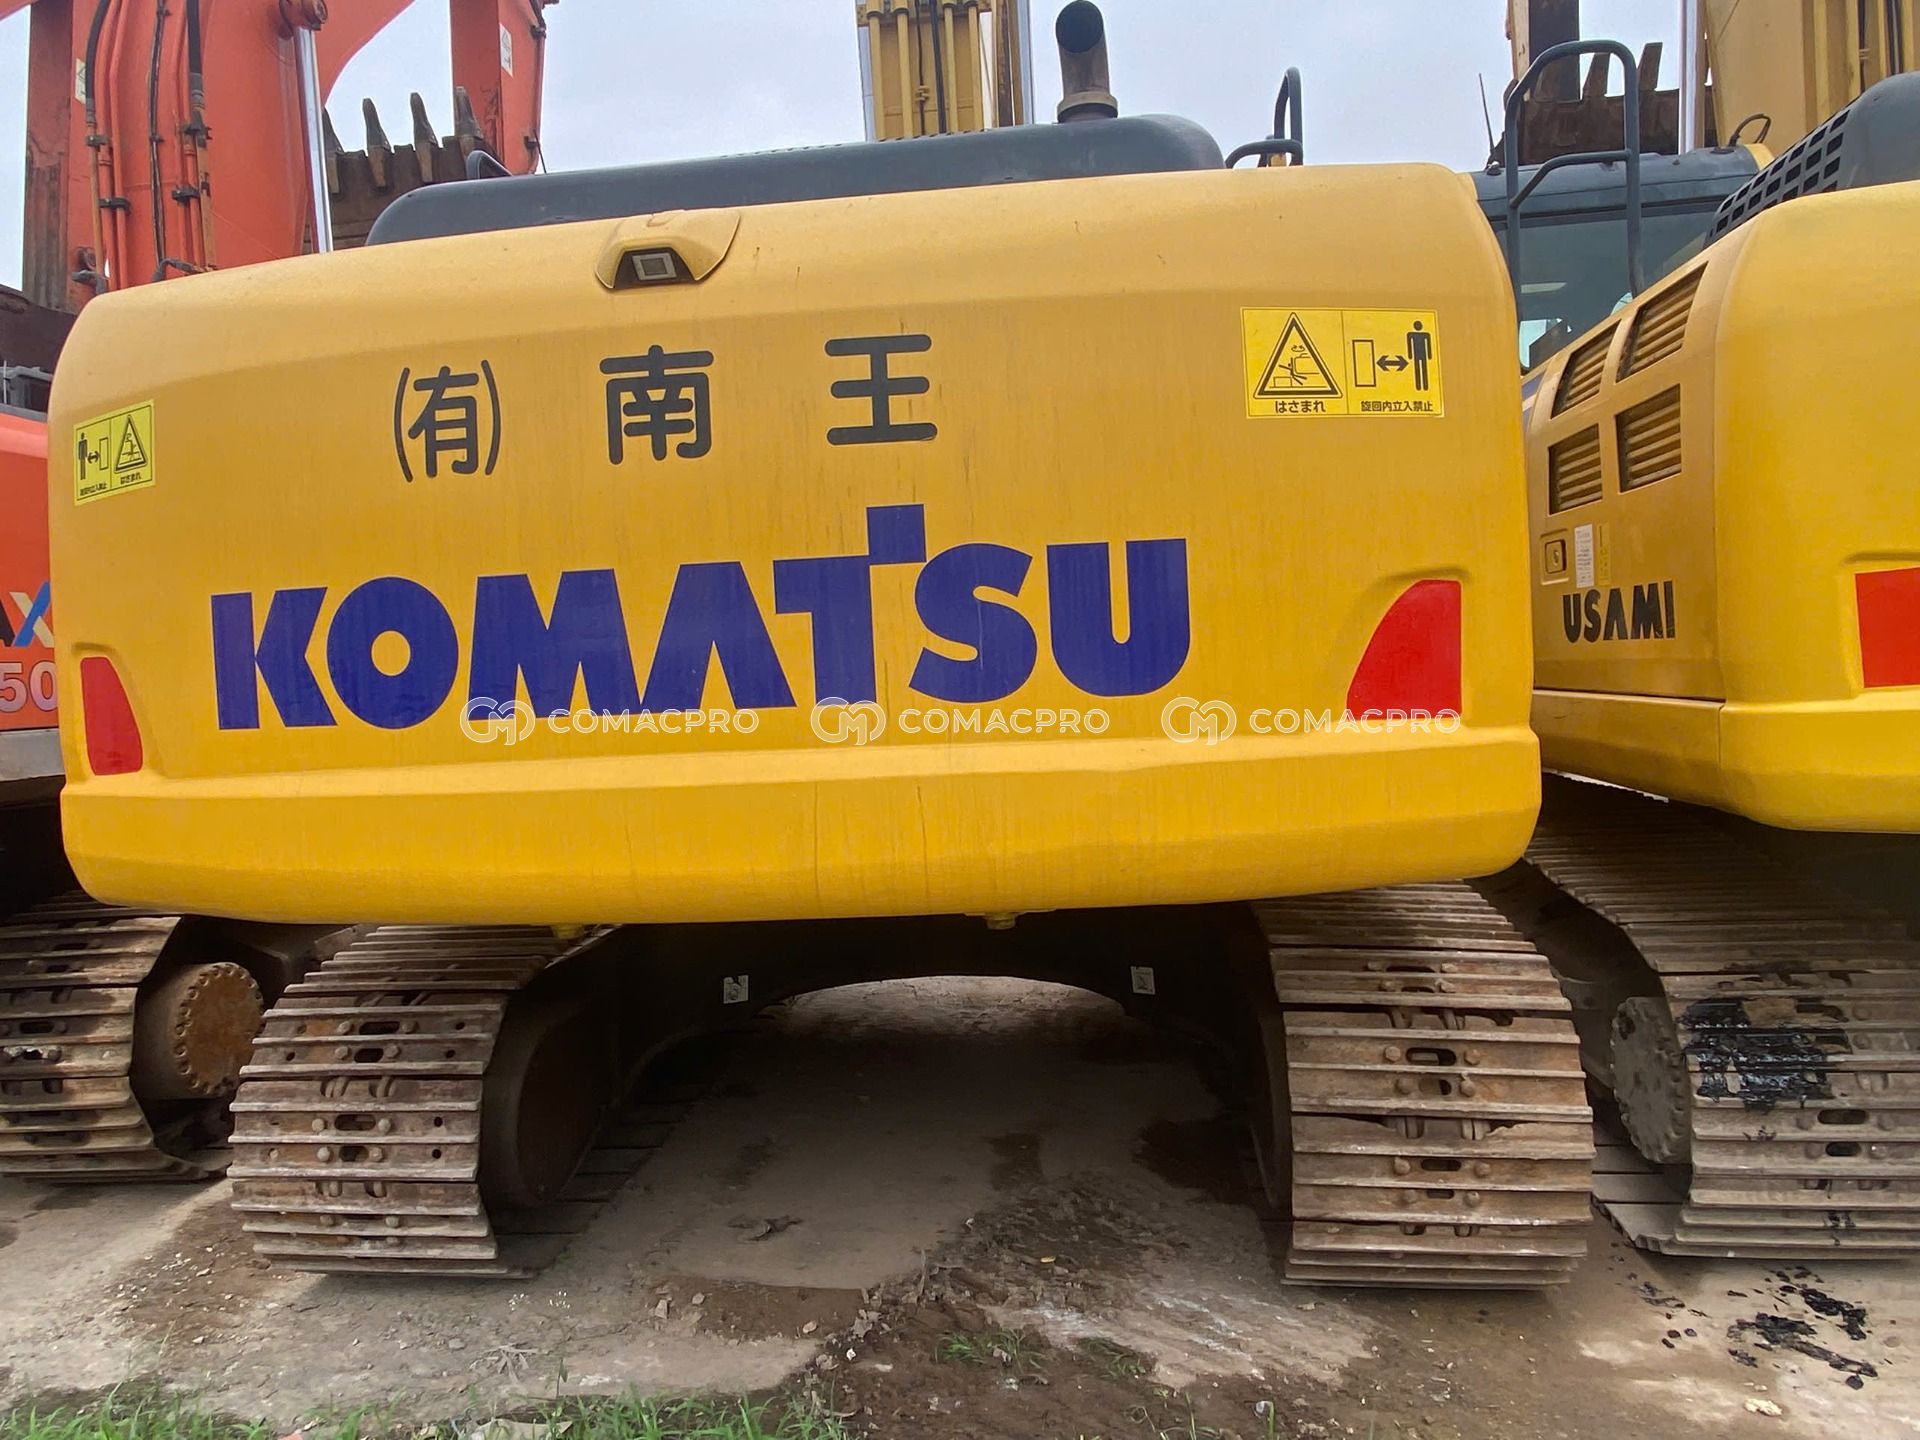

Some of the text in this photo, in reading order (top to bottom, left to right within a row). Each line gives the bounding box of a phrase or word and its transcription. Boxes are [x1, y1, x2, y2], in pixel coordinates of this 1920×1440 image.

[1275, 400, 1326, 413] はさまれ
[1360, 401, 1433, 412] 旋回内立入禁止
[211, 503, 1191, 730] KOMATSU
[1562, 580, 1675, 643] USAMI
